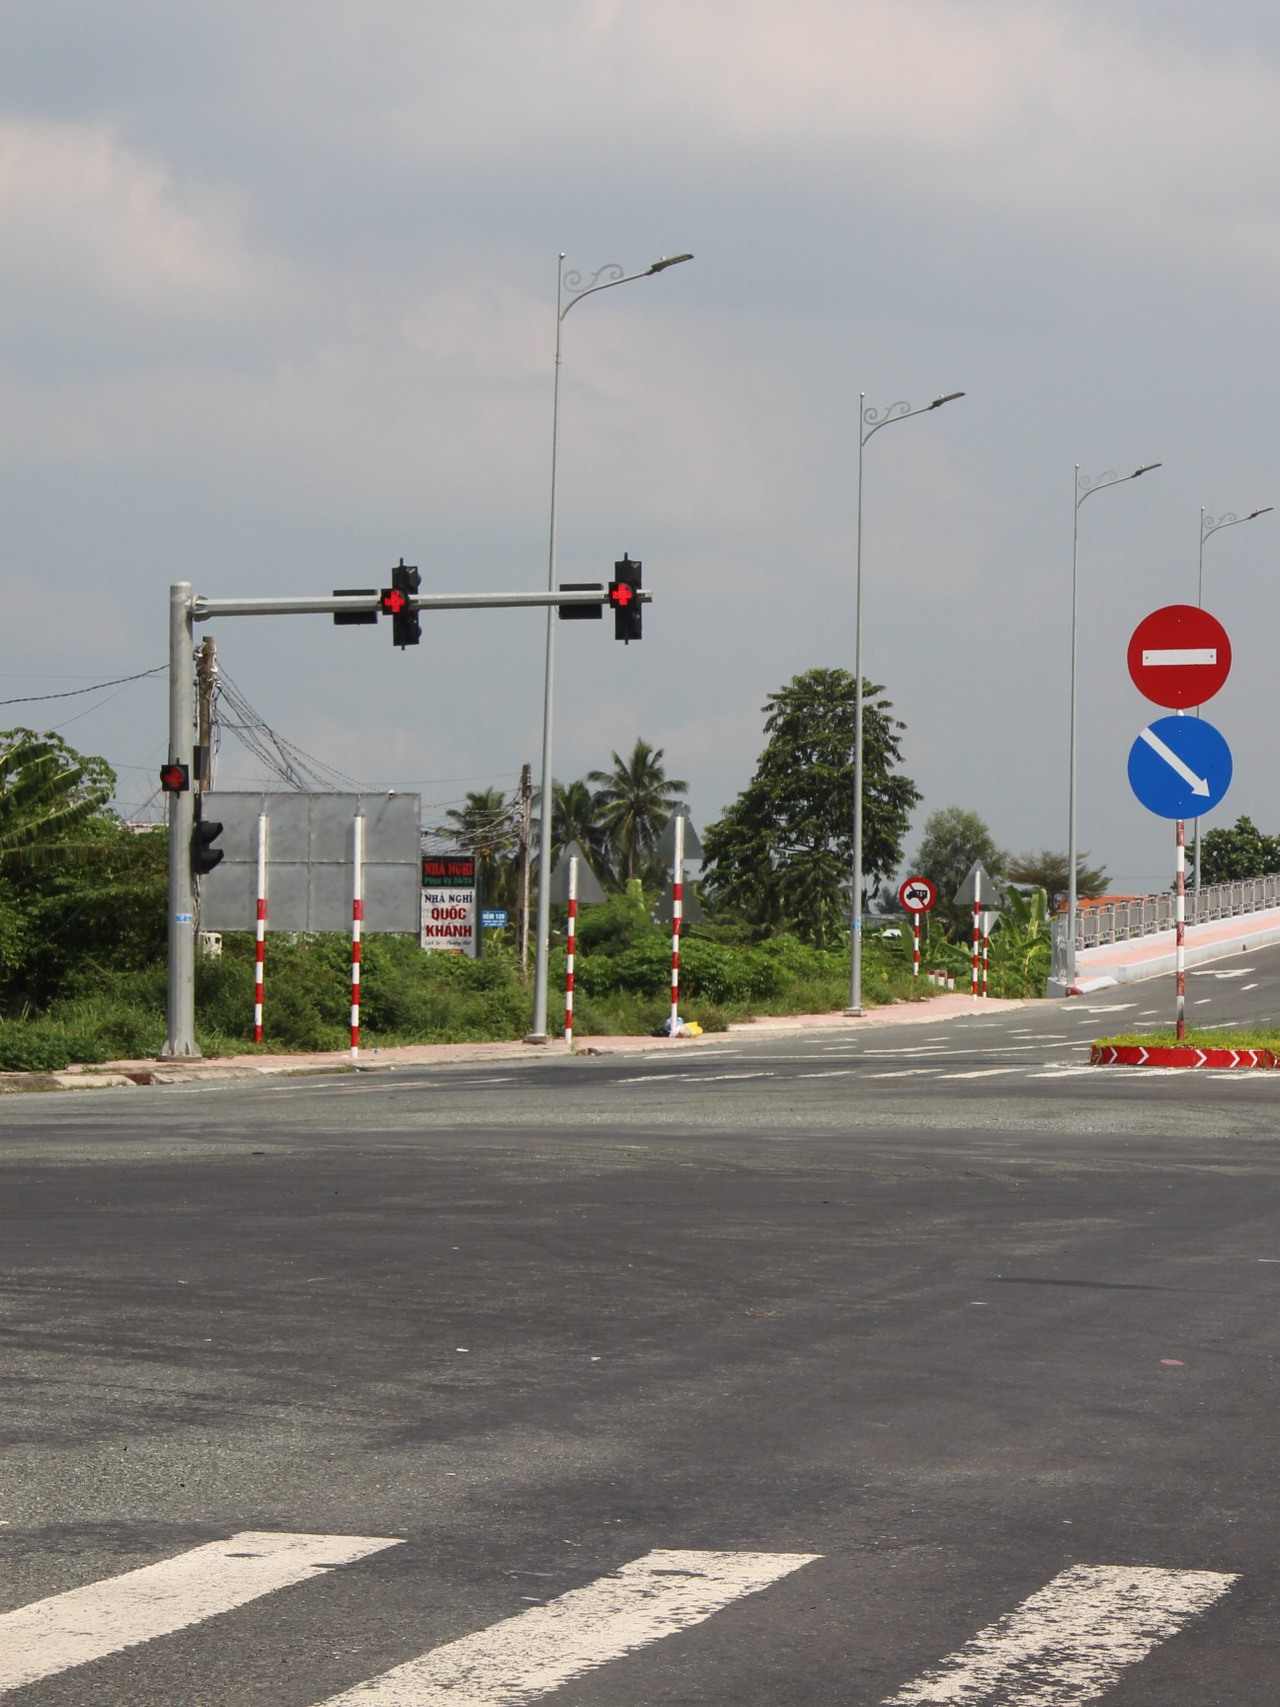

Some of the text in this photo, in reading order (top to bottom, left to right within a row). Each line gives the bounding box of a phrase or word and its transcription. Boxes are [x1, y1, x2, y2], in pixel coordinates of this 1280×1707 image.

[424, 891, 473, 903] NHÀ NGHỈ
[431, 904, 467, 921] QUỐC
[425, 922, 473, 938] KHÁNH
